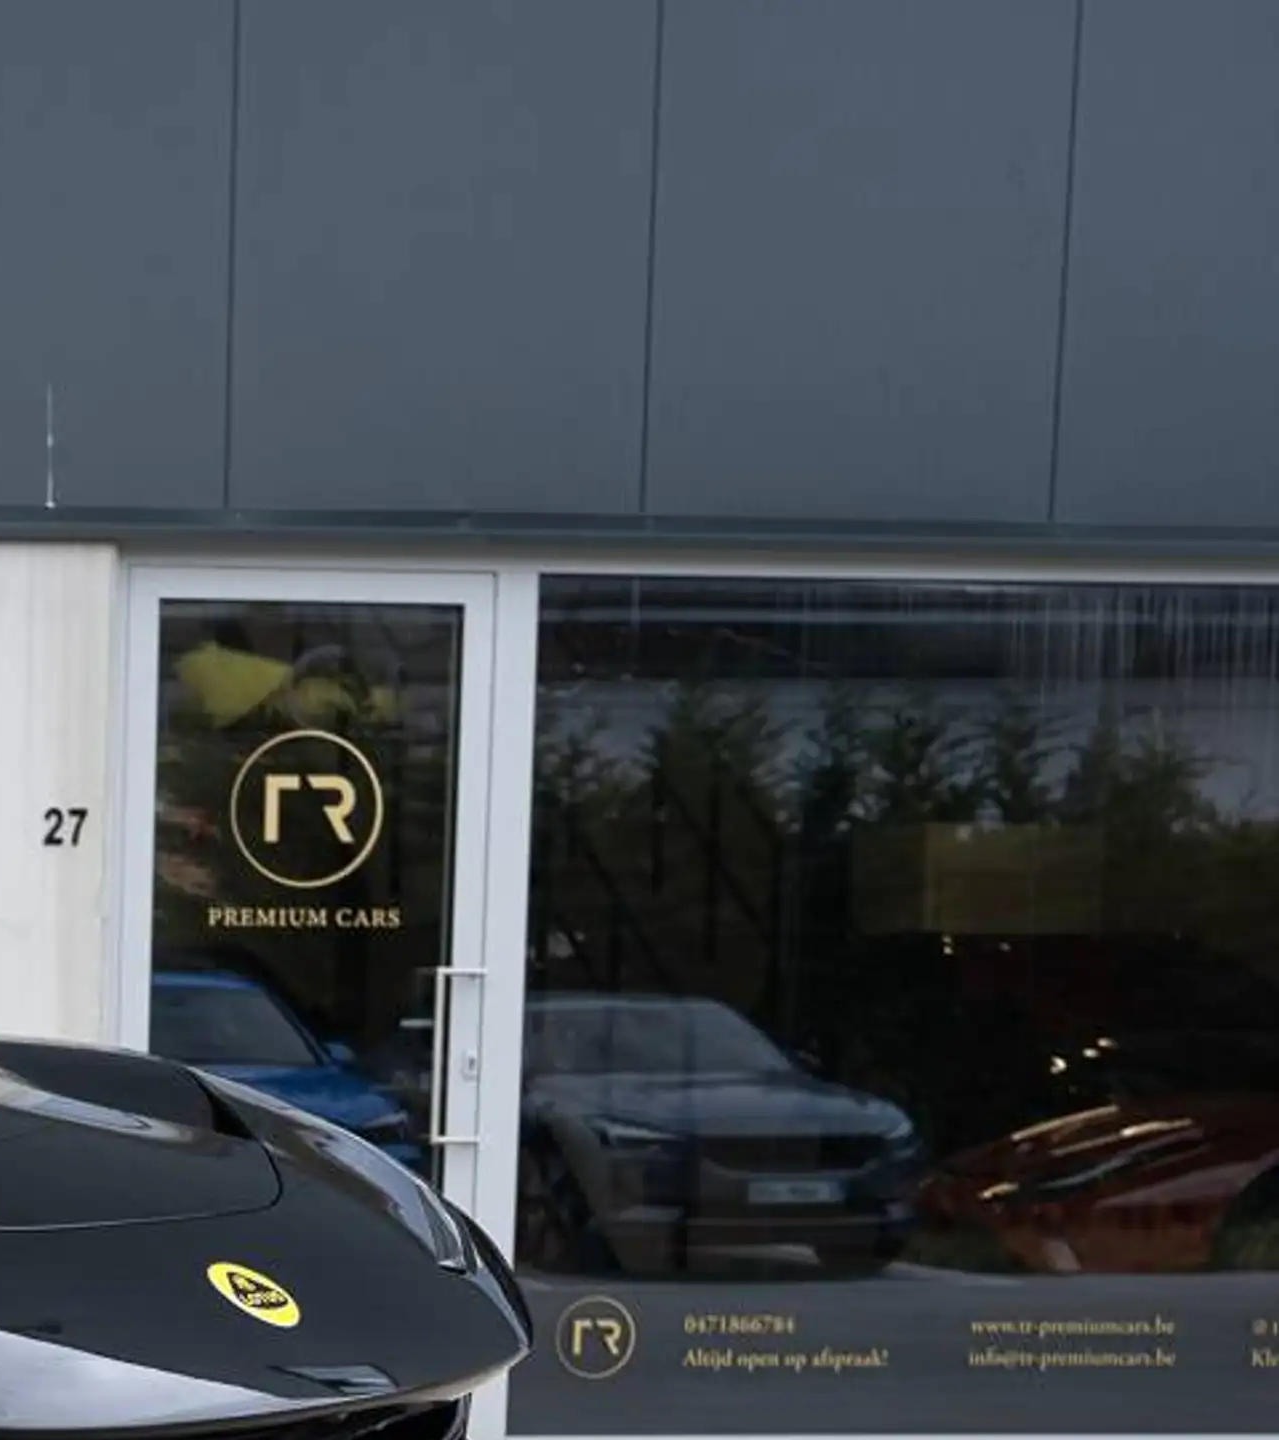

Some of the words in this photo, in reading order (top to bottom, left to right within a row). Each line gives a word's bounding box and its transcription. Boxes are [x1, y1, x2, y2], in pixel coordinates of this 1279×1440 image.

[43, 808, 88, 847] 27
[208, 906, 328, 928] PREMIUM
[335, 907, 402, 929] CARS
[736, 1353, 780, 1374] open
[783, 1353, 808, 1374] op
